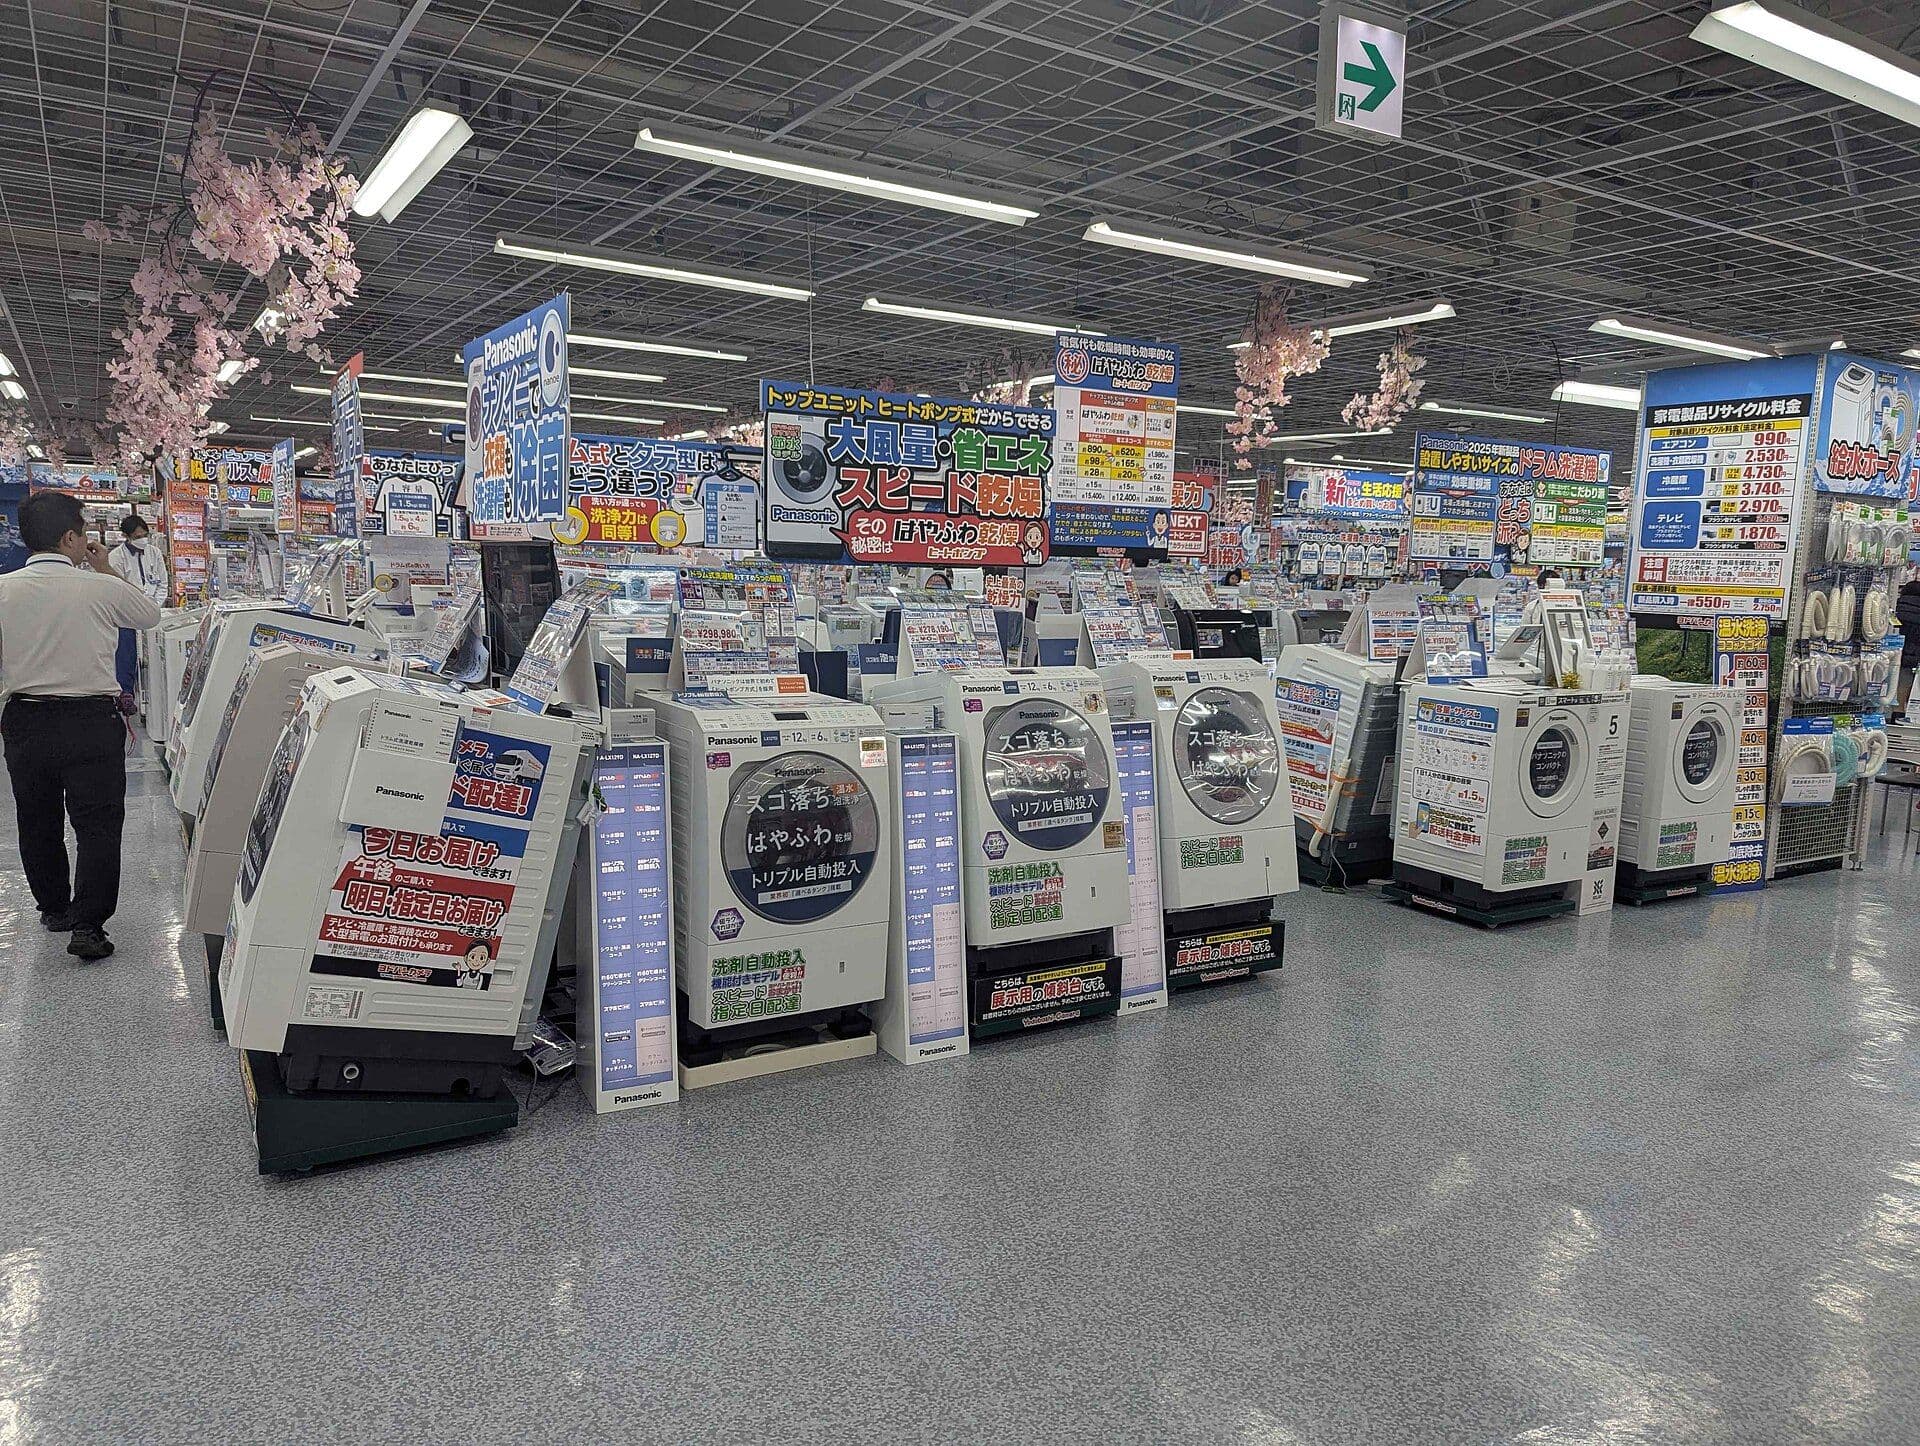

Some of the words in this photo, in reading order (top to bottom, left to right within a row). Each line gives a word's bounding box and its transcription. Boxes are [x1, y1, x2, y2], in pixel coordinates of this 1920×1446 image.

[484, 319, 538, 371] Panasonic
[1059, 336, 1176, 361] 電気代も乾燥時間も効率的な
[1091, 357, 1175, 384] はやふわ乾燥
[482, 365, 541, 434] ナノイーで
[769, 387, 874, 416] トップユニット
[879, 402, 1053, 432] ヒートポンプ式だからできる
[1082, 409, 1124, 421] はやふわ乾燥
[1654, 398, 1802, 426] 家電製品リサイクル料金
[771, 436, 801, 451] 節水
[826, 416, 1053, 475] 大風量・省エネ
[1421, 435, 1468, 451] Panasonic
[1662, 438, 1697, 449] エアコン
[514, 408, 566, 522] 除菌
[570, 438, 717, 472] ム式とタテ型は
[1420, 449, 1518, 474] 設置しやすいサイズの
[1519, 448, 1598, 483] ドラム洗濯機
[1828, 439, 1900, 483] 給水ホース
[1362, 481, 1404, 498] 生活応援
[1661, 474, 1688, 485] 冷蔵庫
[591, 498, 647, 508] 洗い方が違っても
[836, 467, 1044, 520] スピード乾燥
[590, 508, 648, 526] 洗浄力は
[772, 506, 838, 525] Panasonic
[1499, 498, 1531, 523] どっち
[1656, 513, 1685, 523] テレビ
[601, 524, 638, 542] 同等!
[855, 518, 887, 534] その
[893, 520, 1020, 547] はやふわ乾燥
[851, 535, 893, 555] 秘密は
[927, 547, 987, 560] ヒートポンプ
[1718, 616, 1768, 639] 温水洗浄
[962, 684, 1001, 693] Panasonic
[1152, 675, 1185, 683] Panasonic
[1019, 711, 1059, 720] Panasonic
[1609, 714, 1619, 736] 5
[708, 734, 758, 746] Panasonic
[998, 729, 1066, 752] スゴ落ち
[459, 759, 495, 777] ぐ届く
[774, 765, 826, 778] Panasonic
[375, 784, 425, 802] Panasonic
[746, 785, 832, 815] スゴ落ち
[835, 782, 855, 795] 温水
[1011, 794, 1099, 818] トリプル自動投入
[747, 824, 833, 854] はやふわ
[834, 831, 852, 844] 乾燥
[1180, 838, 1218, 852] スピード
[1430, 825, 1482, 846] 配送料金無料
[361, 826, 500, 869] 今日お届け
[1180, 848, 1245, 869] 指定日配達
[352, 856, 394, 882] 午後
[394, 873, 435, 888] のご購入で
[472, 865, 513, 881] できます!
[751, 859, 862, 889] トリプル自動投入
[988, 860, 1064, 885] 洗剤自動投入
[1713, 862, 1762, 885] 温水洗浄
[344, 880, 505, 928] 明日・指定日お届け
[990, 894, 1034, 914] スピード
[990, 903, 1064, 930] 指定日配達
[325, 927, 454, 952] 大型家電のお取付けも承ります
[328, 917, 439, 940] テレビ・冷蔵庫・洗濯機などの
[457, 923, 499, 939] できます!
[711, 948, 807, 977] 洗剤自動投入
[1176, 939, 1272, 966] 展示用の傾斜台です。
[377, 962, 433, 978] ヨドバシカメラ
[711, 970, 781, 991] 機能付きモデル
[711, 984, 768, 1005] スピード
[991, 976, 1105, 1010] 展示用の傾斜台です。
[1127, 998, 1158, 1009] Panasonic
[711, 994, 802, 1024] 指定日配達
[919, 1044, 957, 1057] Panasonic
[614, 1089, 662, 1105] Panasonic
